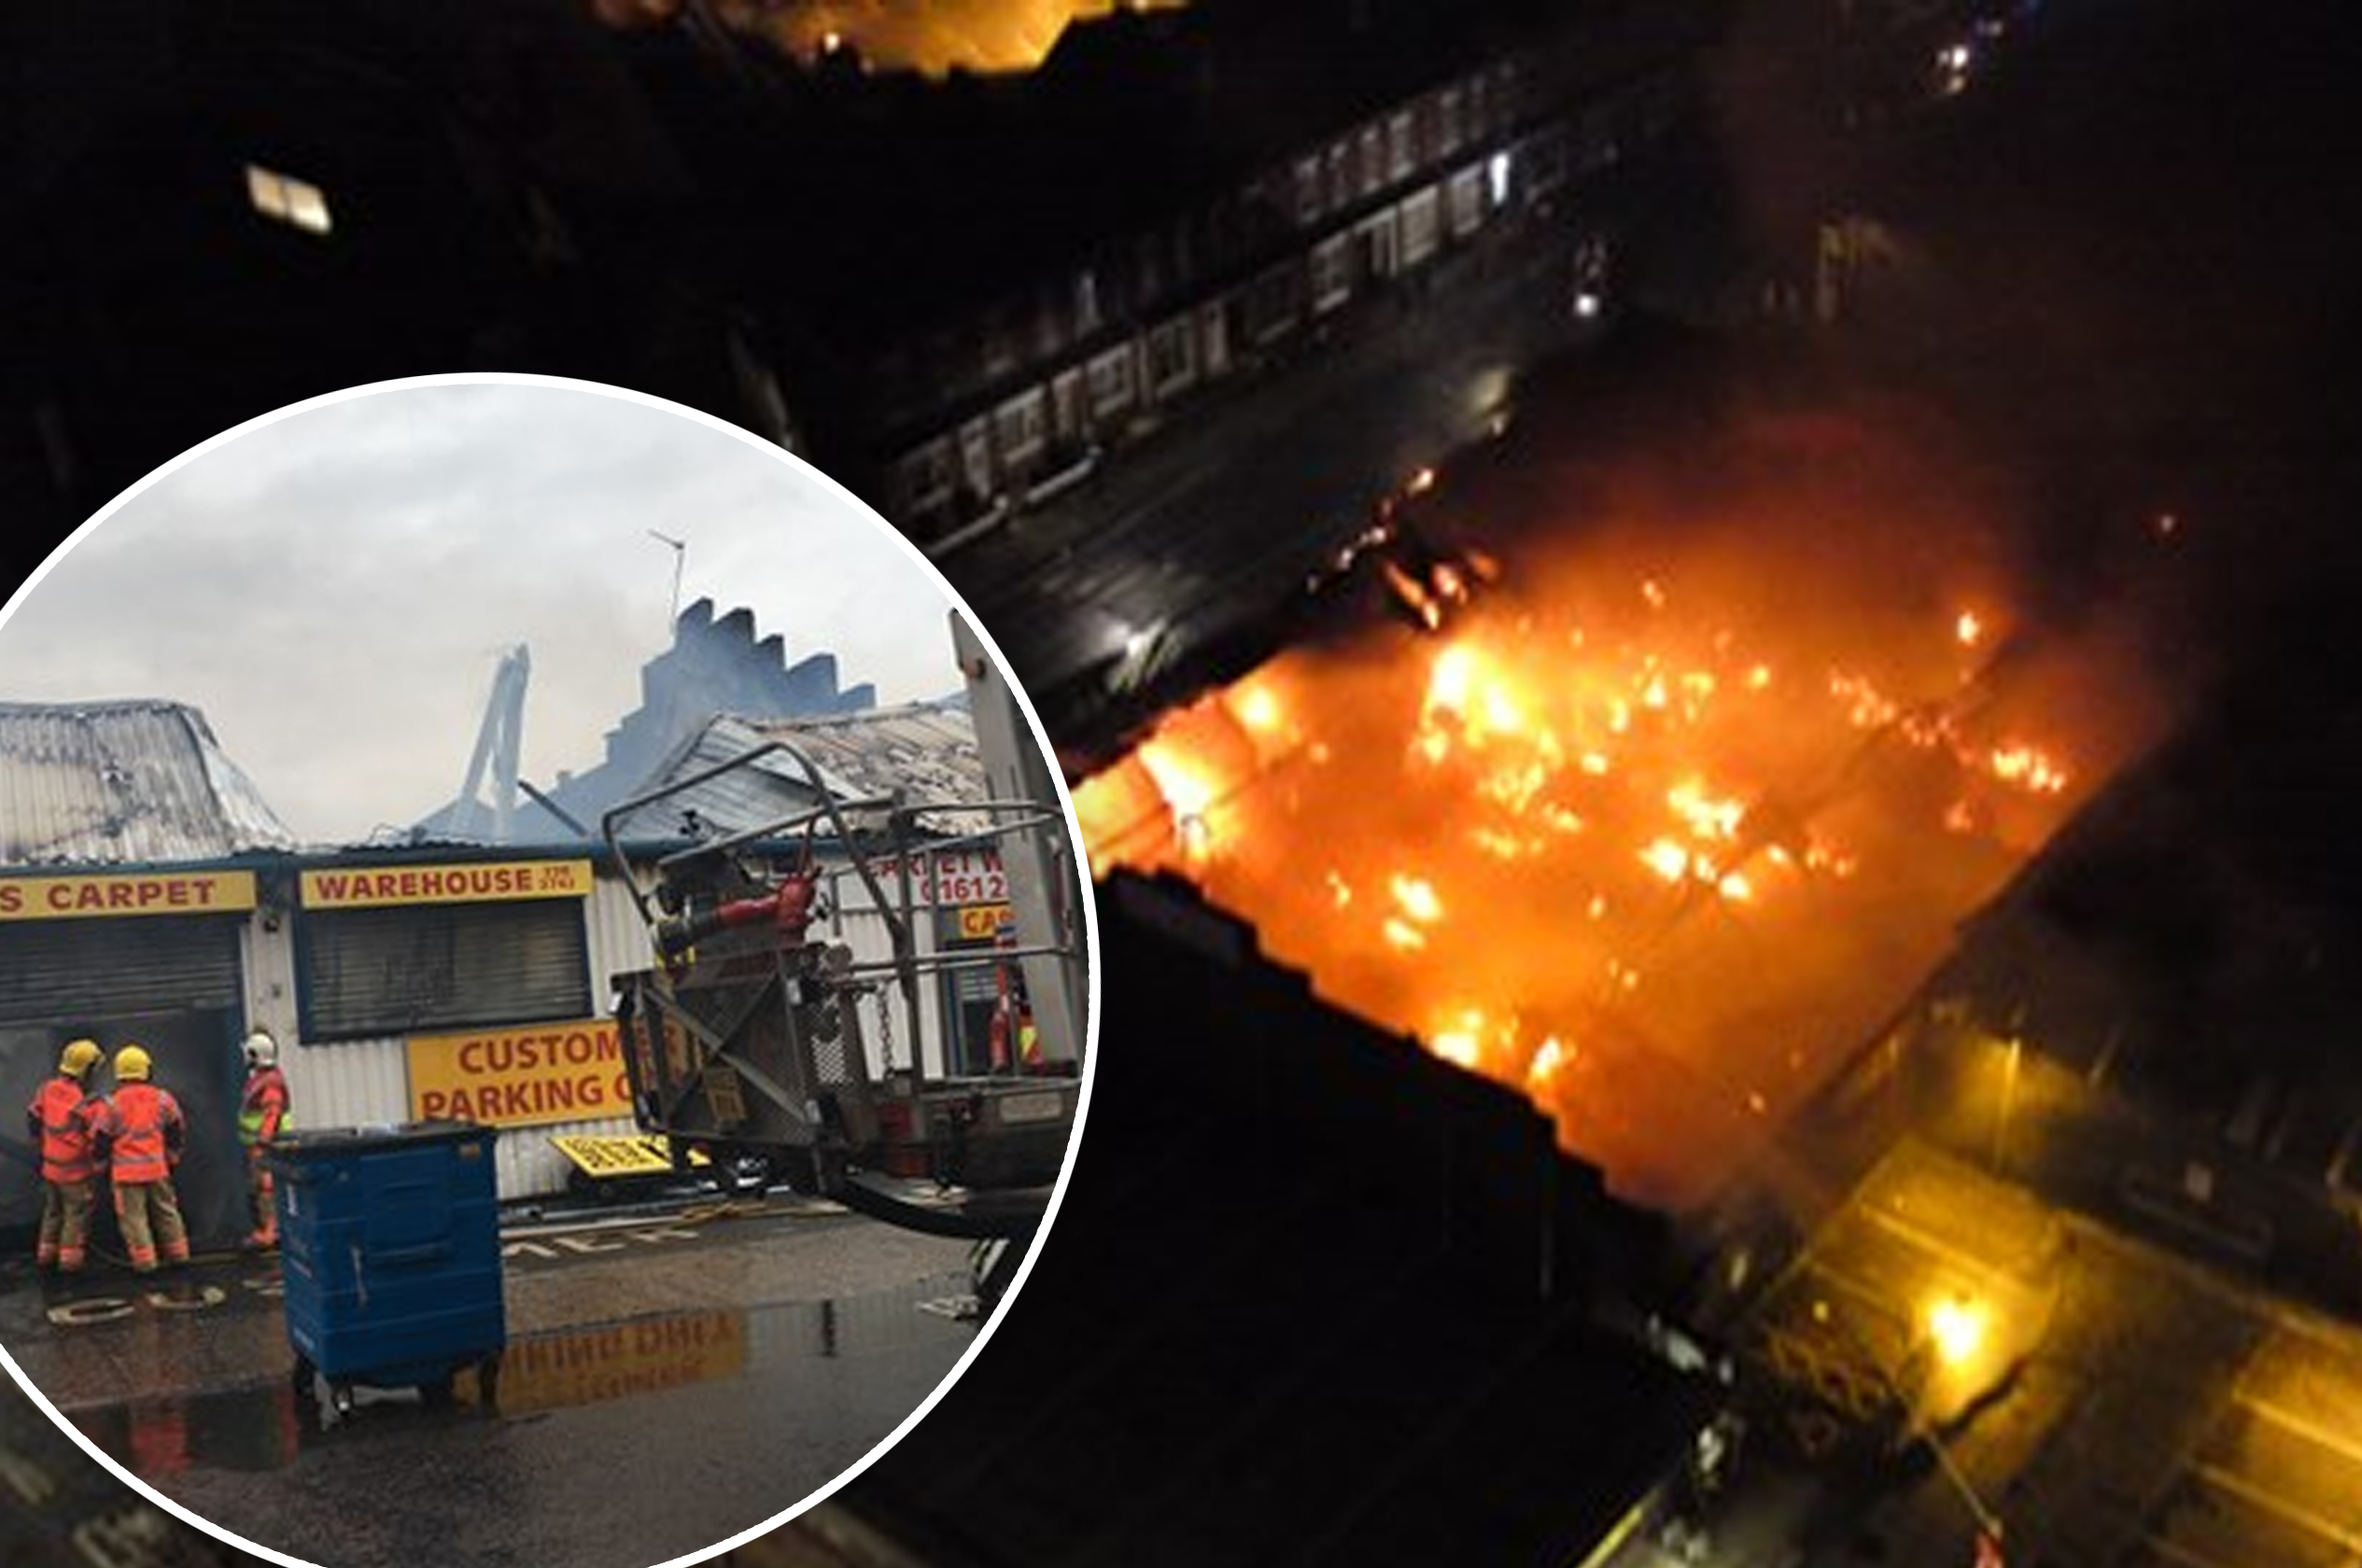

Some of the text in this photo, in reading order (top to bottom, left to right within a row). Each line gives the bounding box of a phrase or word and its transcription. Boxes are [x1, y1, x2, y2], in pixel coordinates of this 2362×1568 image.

[47, 880, 217, 910] CARPET
[316, 869, 533, 901] WAREHOUSE
[457, 1029, 677, 1073] CUSTOM
[422, 1075, 603, 1120] PARKING
